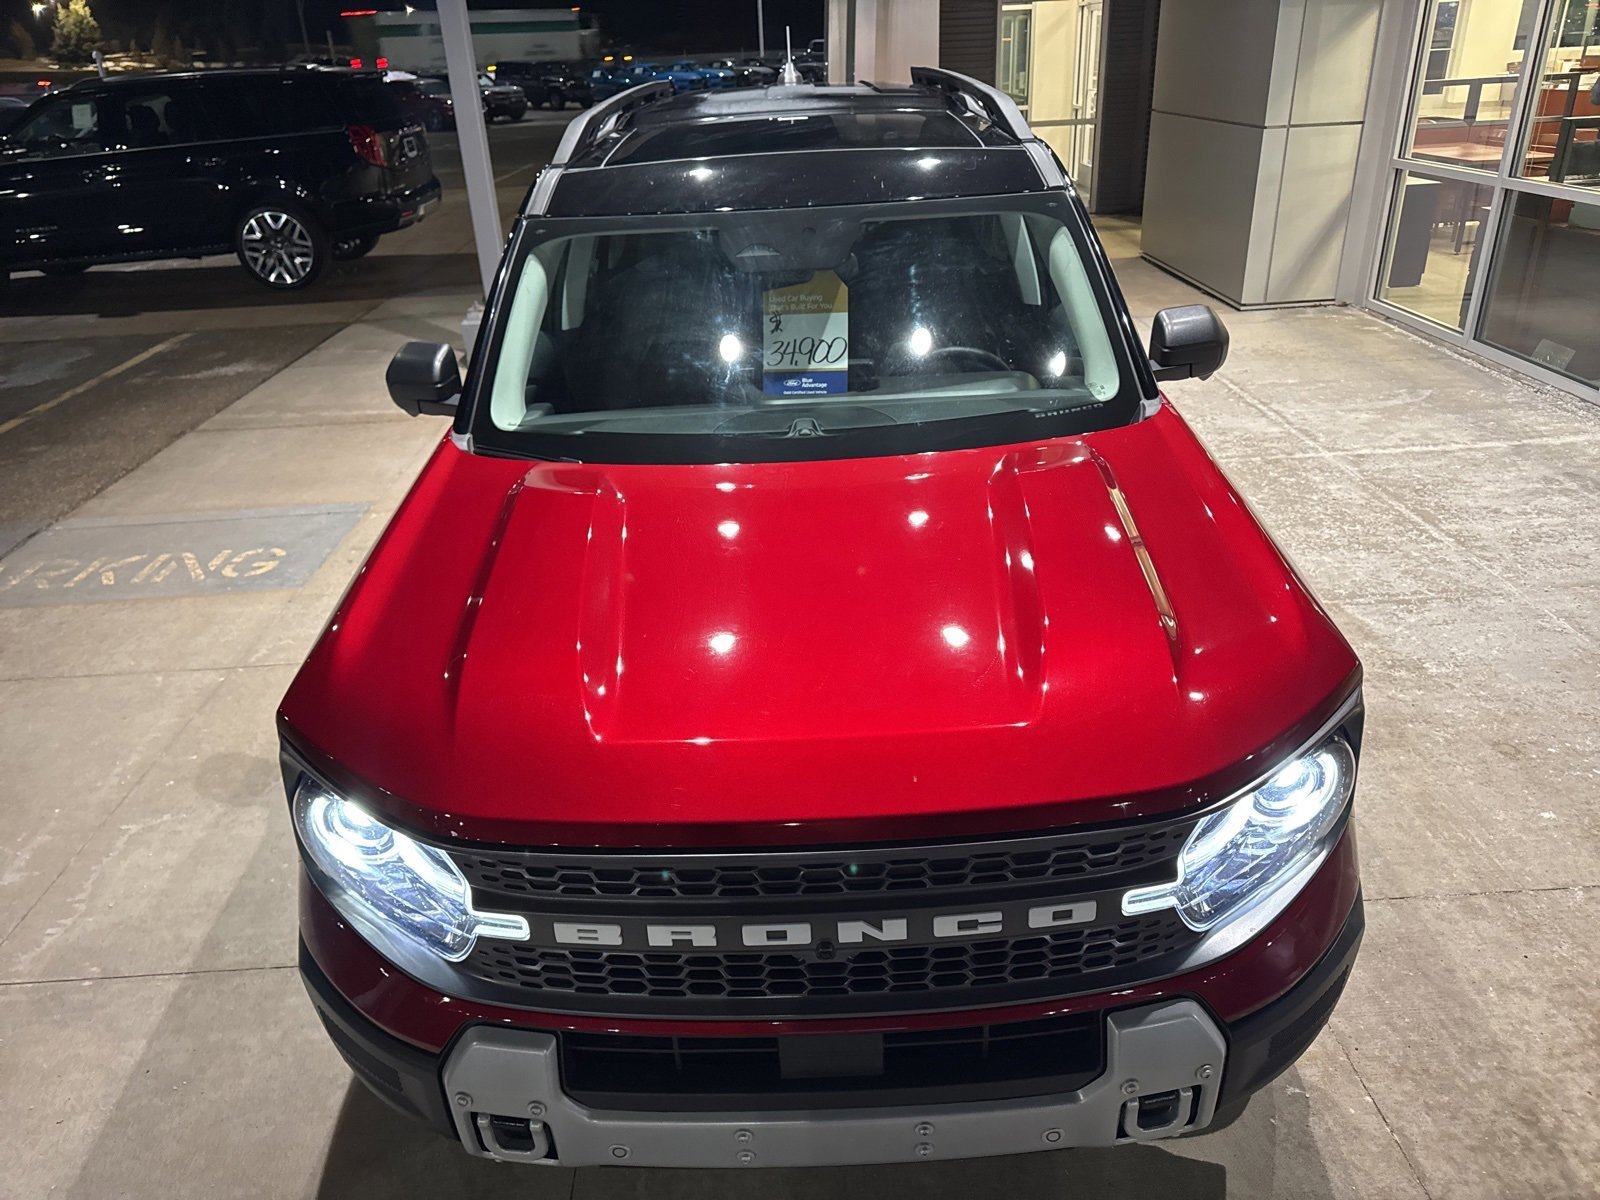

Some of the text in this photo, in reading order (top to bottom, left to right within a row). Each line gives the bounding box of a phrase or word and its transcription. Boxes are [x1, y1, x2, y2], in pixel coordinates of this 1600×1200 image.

[800, 294, 823, 303] Buying
[807, 302, 818, 310] For
[819, 301, 832, 309] You
[0, 546, 287, 592] RKING
[553, 900, 1098, 947] BRONCO
